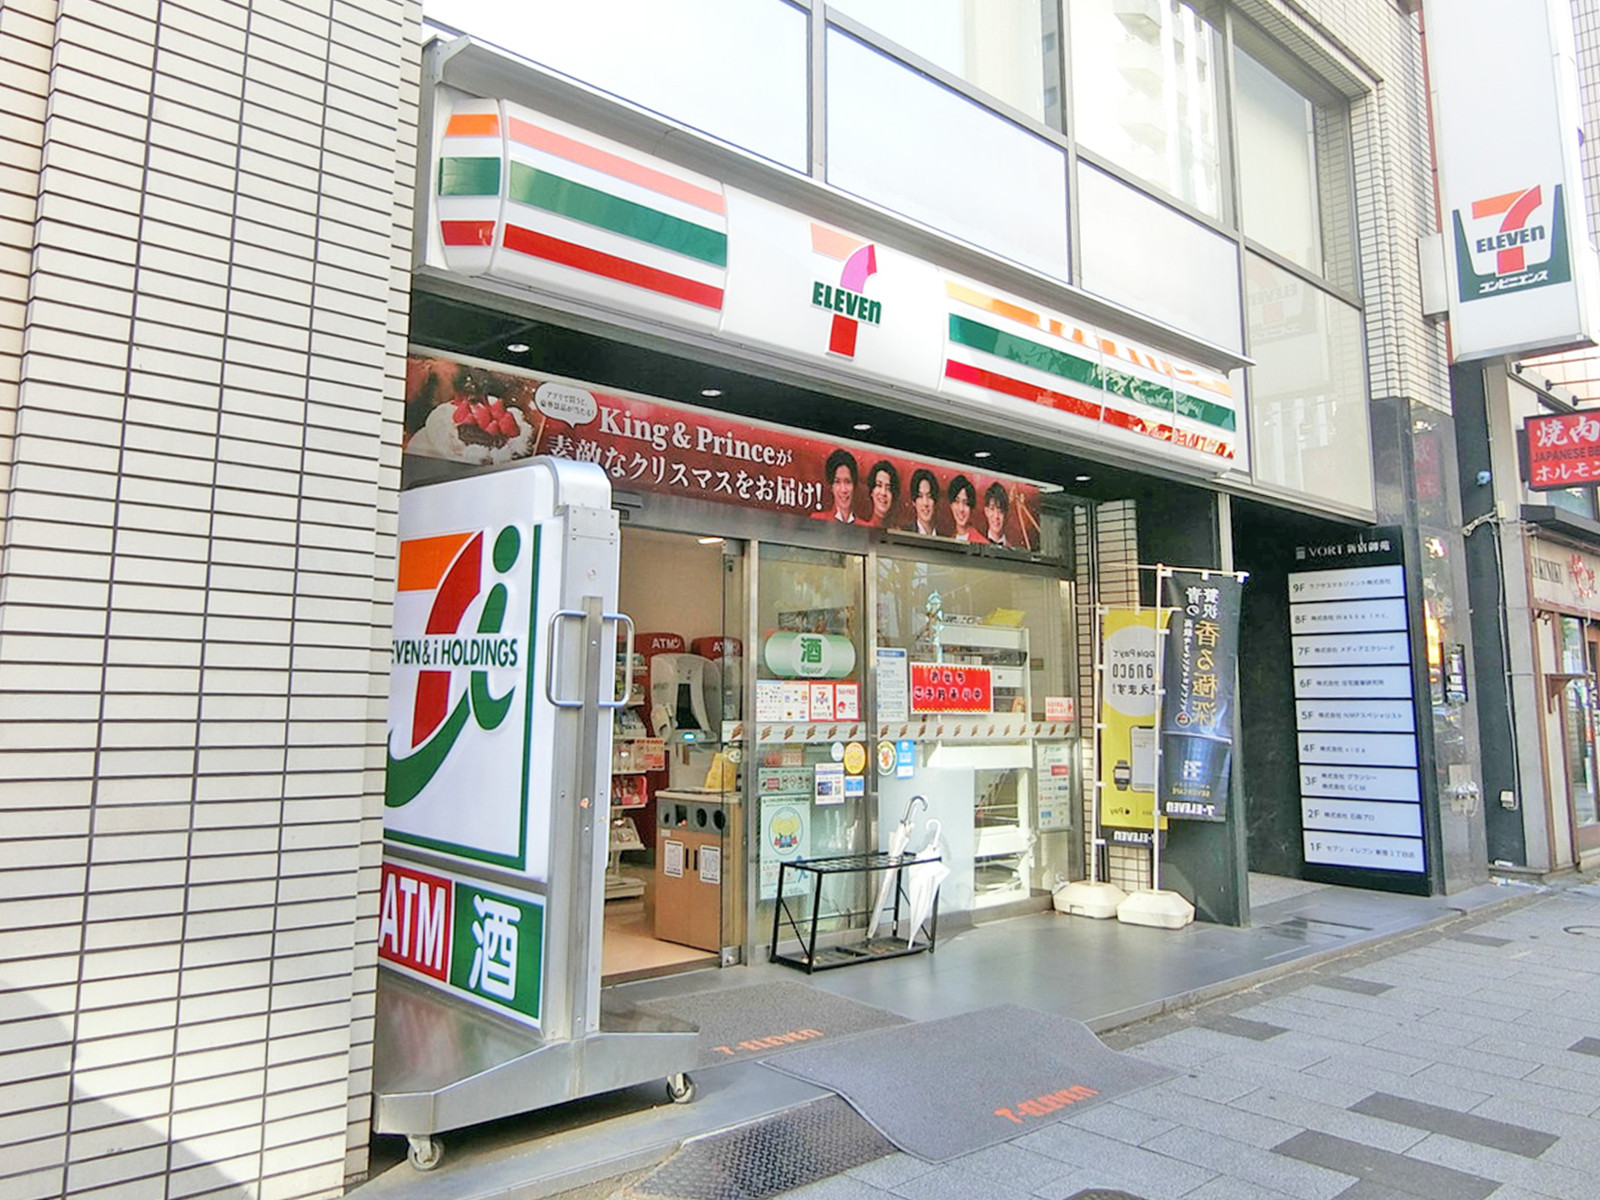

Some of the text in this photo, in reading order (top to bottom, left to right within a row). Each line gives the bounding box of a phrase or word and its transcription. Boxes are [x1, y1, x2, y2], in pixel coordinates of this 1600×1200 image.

[599, 405, 670, 450] King
[671, 421, 692, 449] &
[1536, 415, 1600, 448] 焼肉
[1534, 448, 1586, 462] JAPANESE
[1292, 583, 1306, 593] 9F
[1294, 614, 1307, 624] 8F
[441, 638, 518, 667] HOLDINGS
[801, 637, 822, 663] 酒
[1298, 647, 1310, 656] 7F
[1300, 679, 1312, 688] 6F
[1301, 711, 1313, 720] 5F
[1303, 744, 1315, 753] 4F
[1304, 776, 1317, 786] 3F
[1307, 809, 1320, 819] 2F
[1310, 842, 1322, 852] 1F
[379, 872, 447, 970] ATM
[469, 894, 522, 1001] 酒
